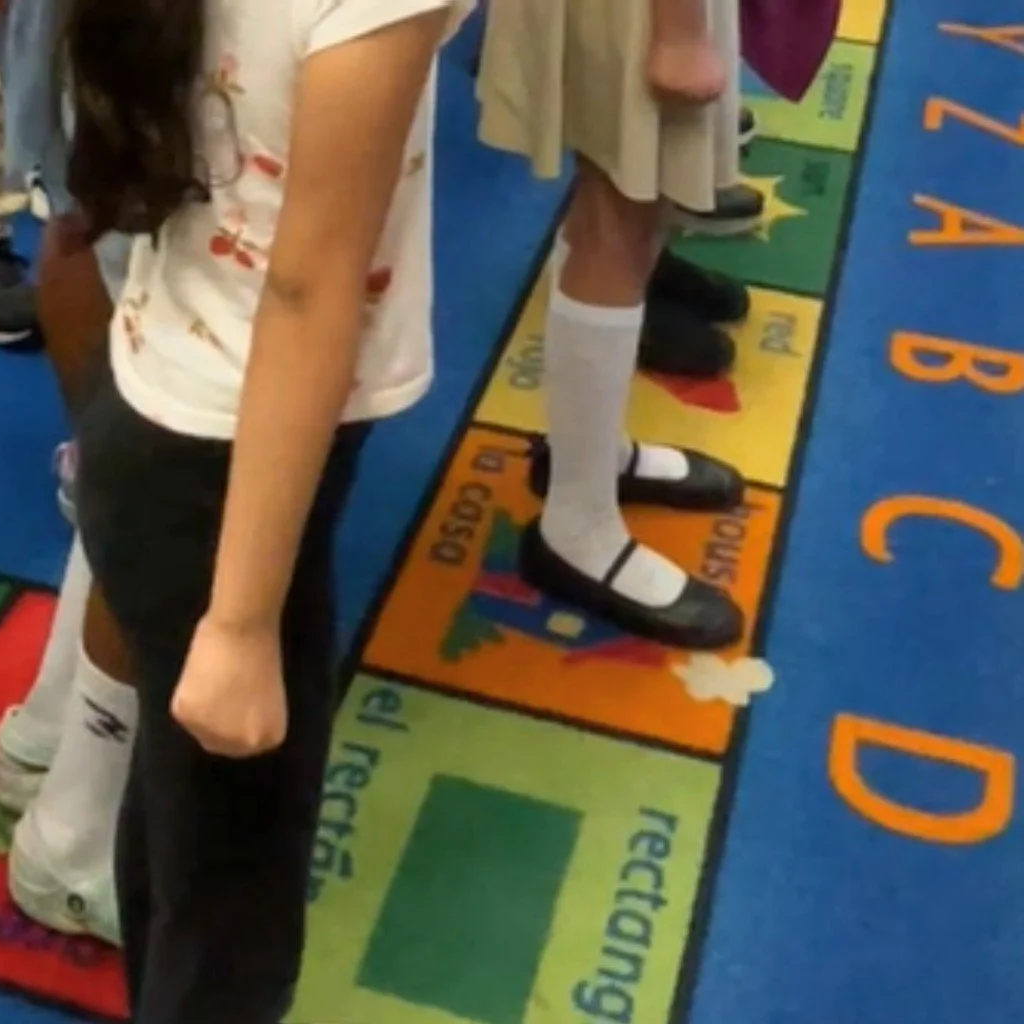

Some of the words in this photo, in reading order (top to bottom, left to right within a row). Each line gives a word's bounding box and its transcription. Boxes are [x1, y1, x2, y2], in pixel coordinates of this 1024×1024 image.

[922, 97, 1024, 148] Z
[906, 192, 1024, 245] A
[760, 309, 803, 359] red
[888, 330, 1024, 396] B
[429, 480, 493, 567] casa
[859, 494, 1024, 591] C
[356, 686, 410, 733] el
[827, 712, 1017, 846] D
[571, 804, 681, 1024] rectang
